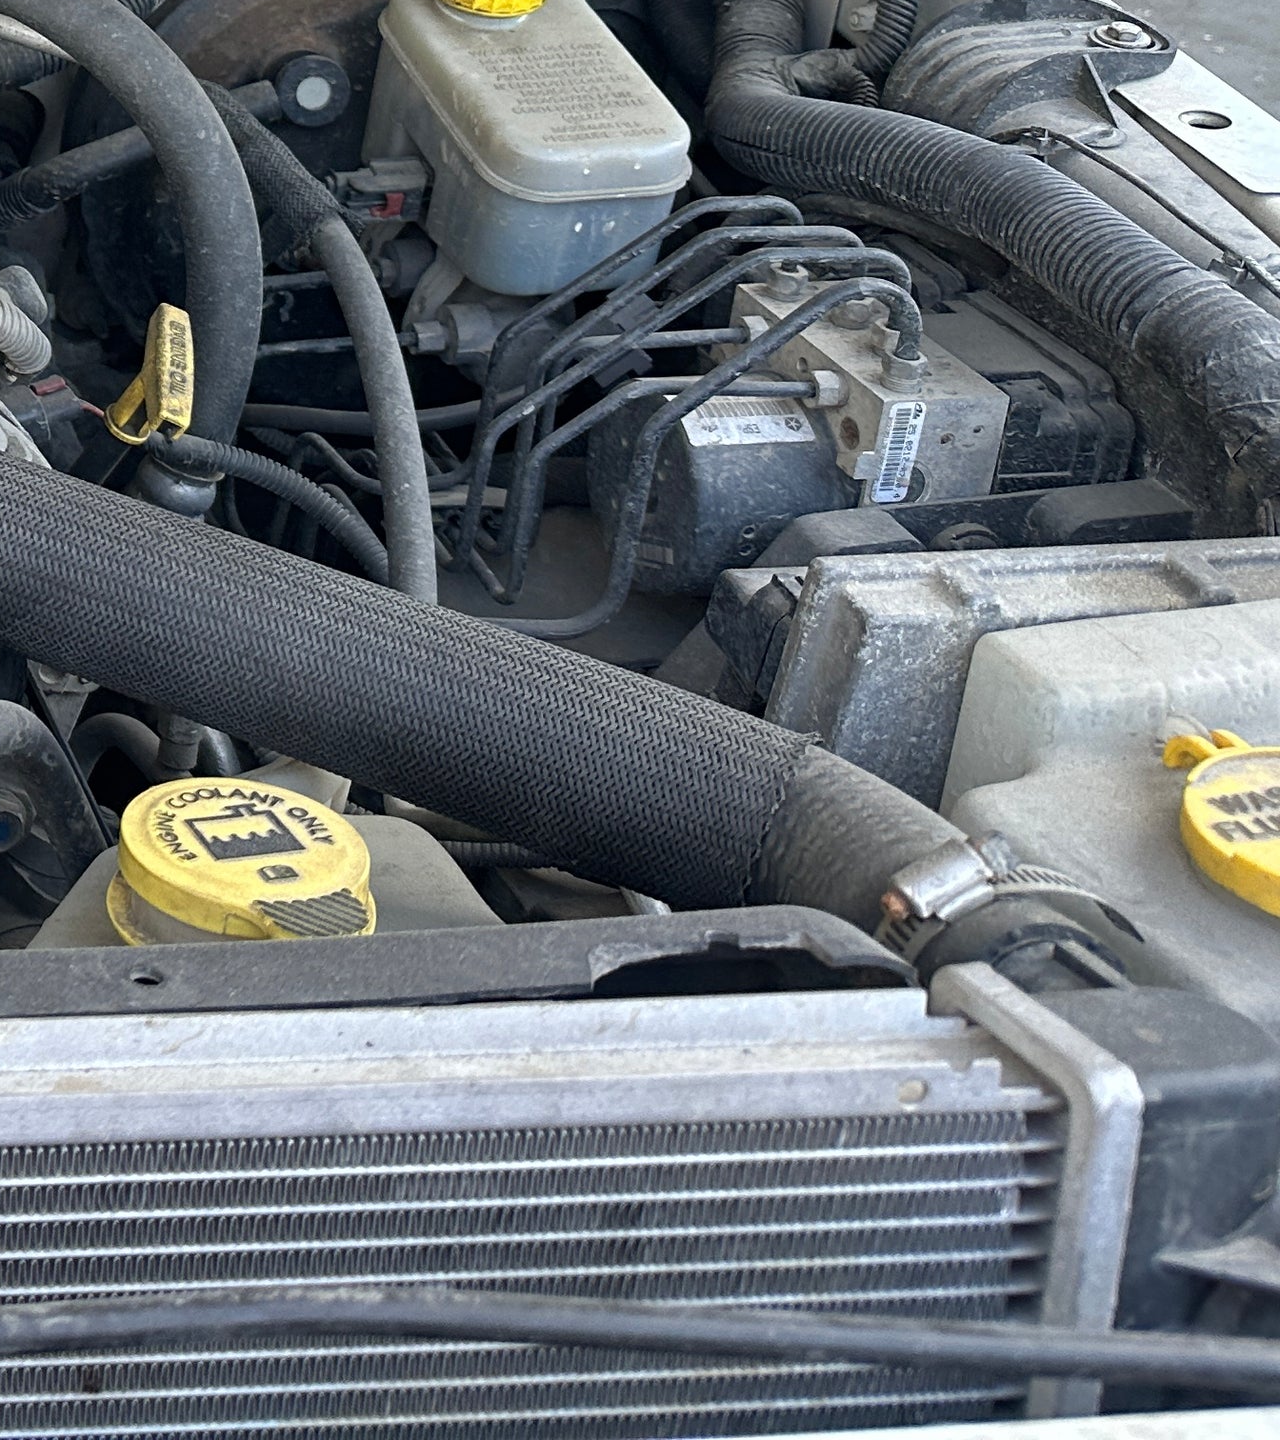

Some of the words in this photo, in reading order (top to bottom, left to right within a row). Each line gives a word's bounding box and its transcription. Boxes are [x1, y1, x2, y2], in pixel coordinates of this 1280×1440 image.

[170, 371, 187, 396] OIL
[166, 787, 285, 809] COOLANT
[154, 809, 198, 863] ENGINE
[286, 806, 335, 846] ONLY
